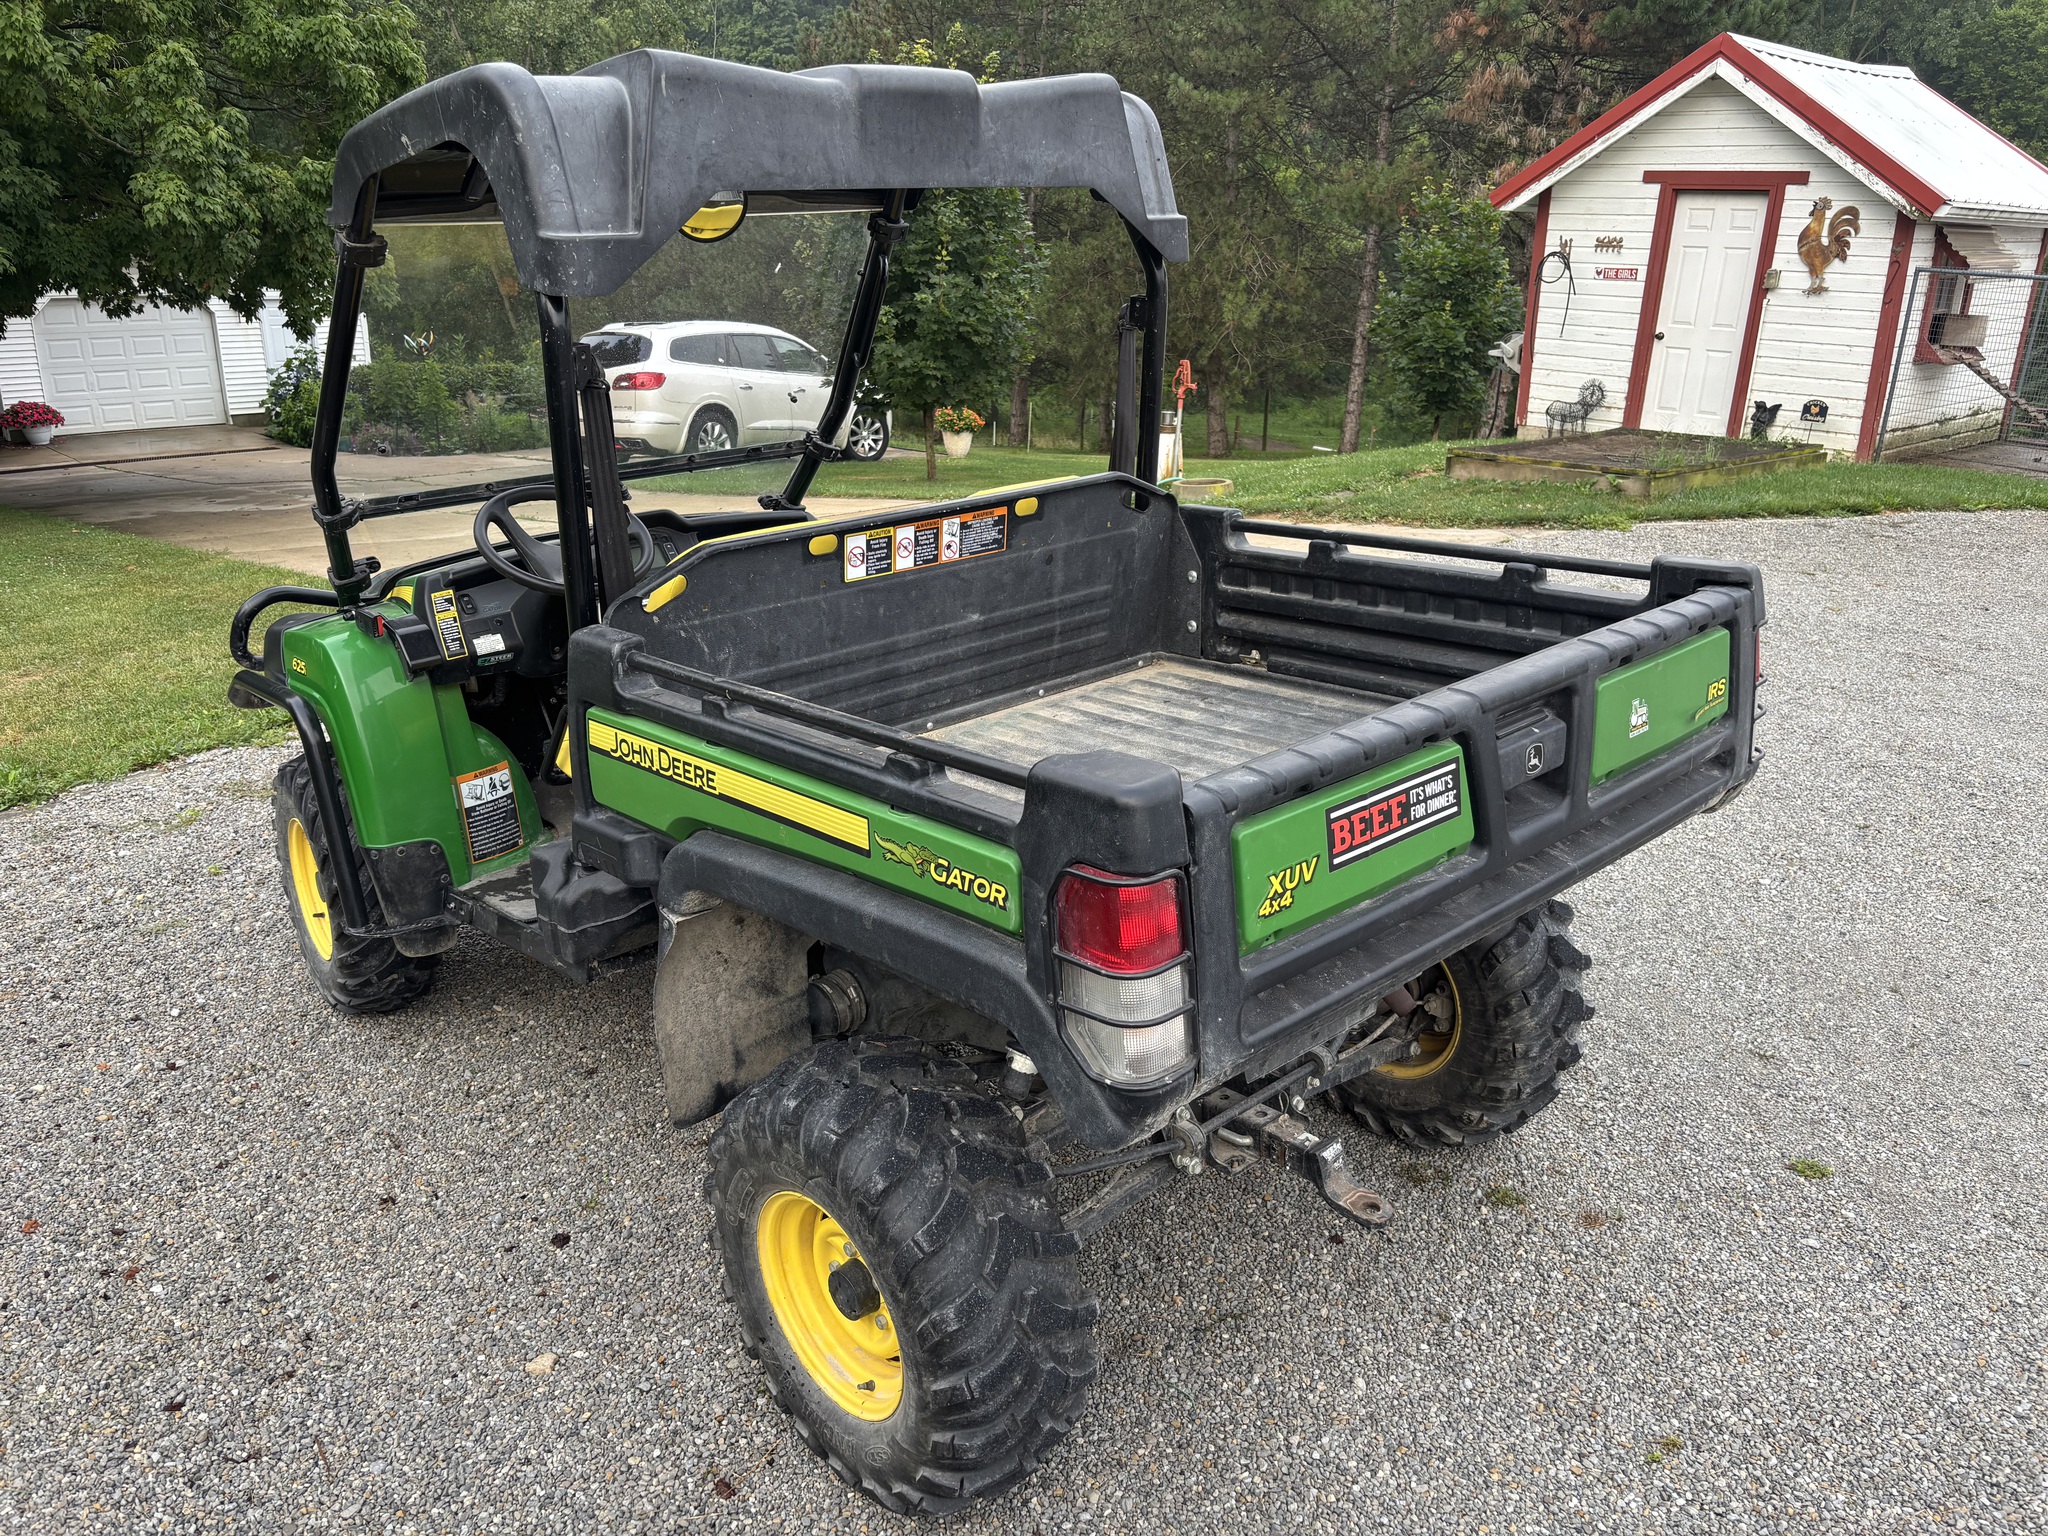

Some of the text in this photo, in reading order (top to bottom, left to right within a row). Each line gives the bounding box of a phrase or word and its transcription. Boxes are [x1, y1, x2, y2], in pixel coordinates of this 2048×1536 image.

[1604, 268, 1637, 279] THE GIRLS
[1708, 678, 1726, 701] IRS
[609, 731, 718, 794] JOHN DEERE
[1410, 775, 1453, 804] IT'S WHAT'S
[1331, 793, 1408, 855] BEEF.
[1410, 804, 1426, 820] FOR
[929, 857, 1008, 910] GATOR
[1267, 856, 1318, 898] XUV
[1258, 890, 1293, 918] 4x4
